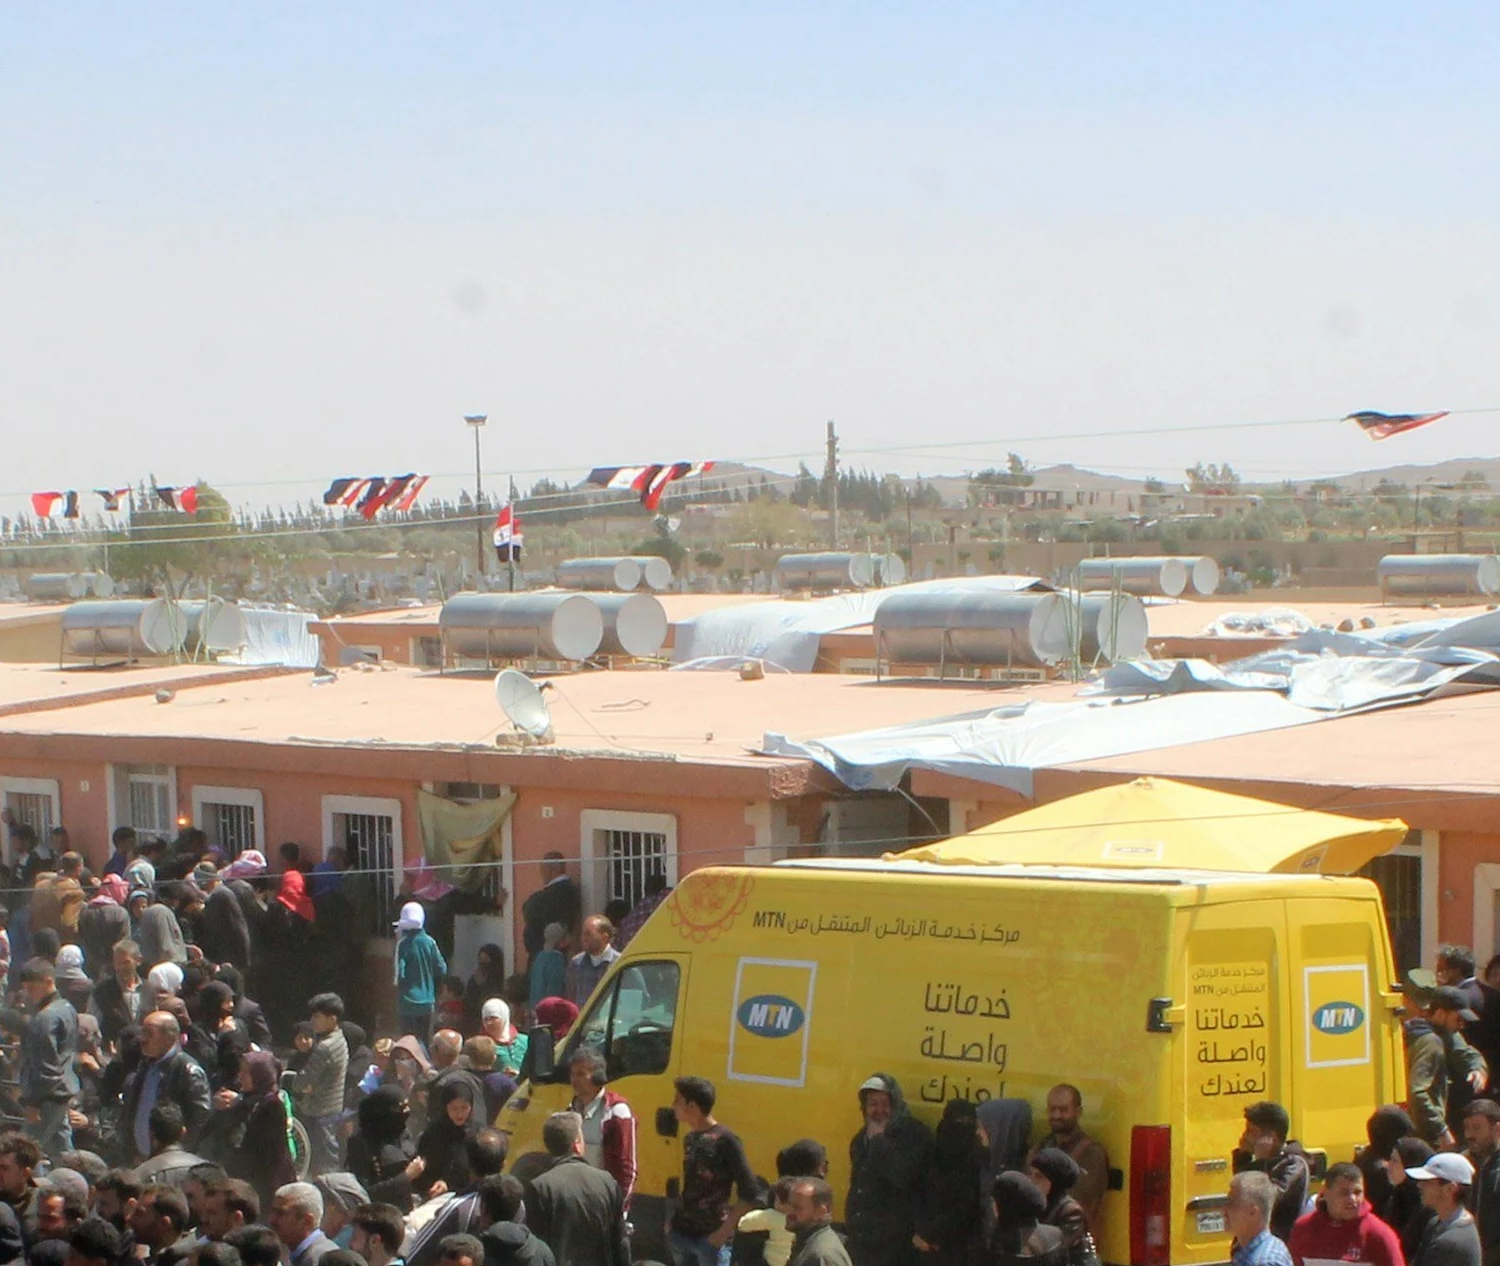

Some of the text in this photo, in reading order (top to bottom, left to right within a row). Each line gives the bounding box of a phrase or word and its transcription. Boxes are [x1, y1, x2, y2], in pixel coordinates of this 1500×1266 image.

[753, 911, 1021, 947] مركز خدمة الزبائن المتنقل من MTN
[925, 982, 1011, 1020] خدماتنا
[747, 1003, 794, 1030] MTN
[1195, 1006, 1266, 1031] خدماتنا
[1319, 1007, 1356, 1029] MTN
[920, 1025, 1008, 1075] واصلة
[1197, 1039, 1267, 1068] واصلة
[1200, 1071, 1267, 1097] لعندك
